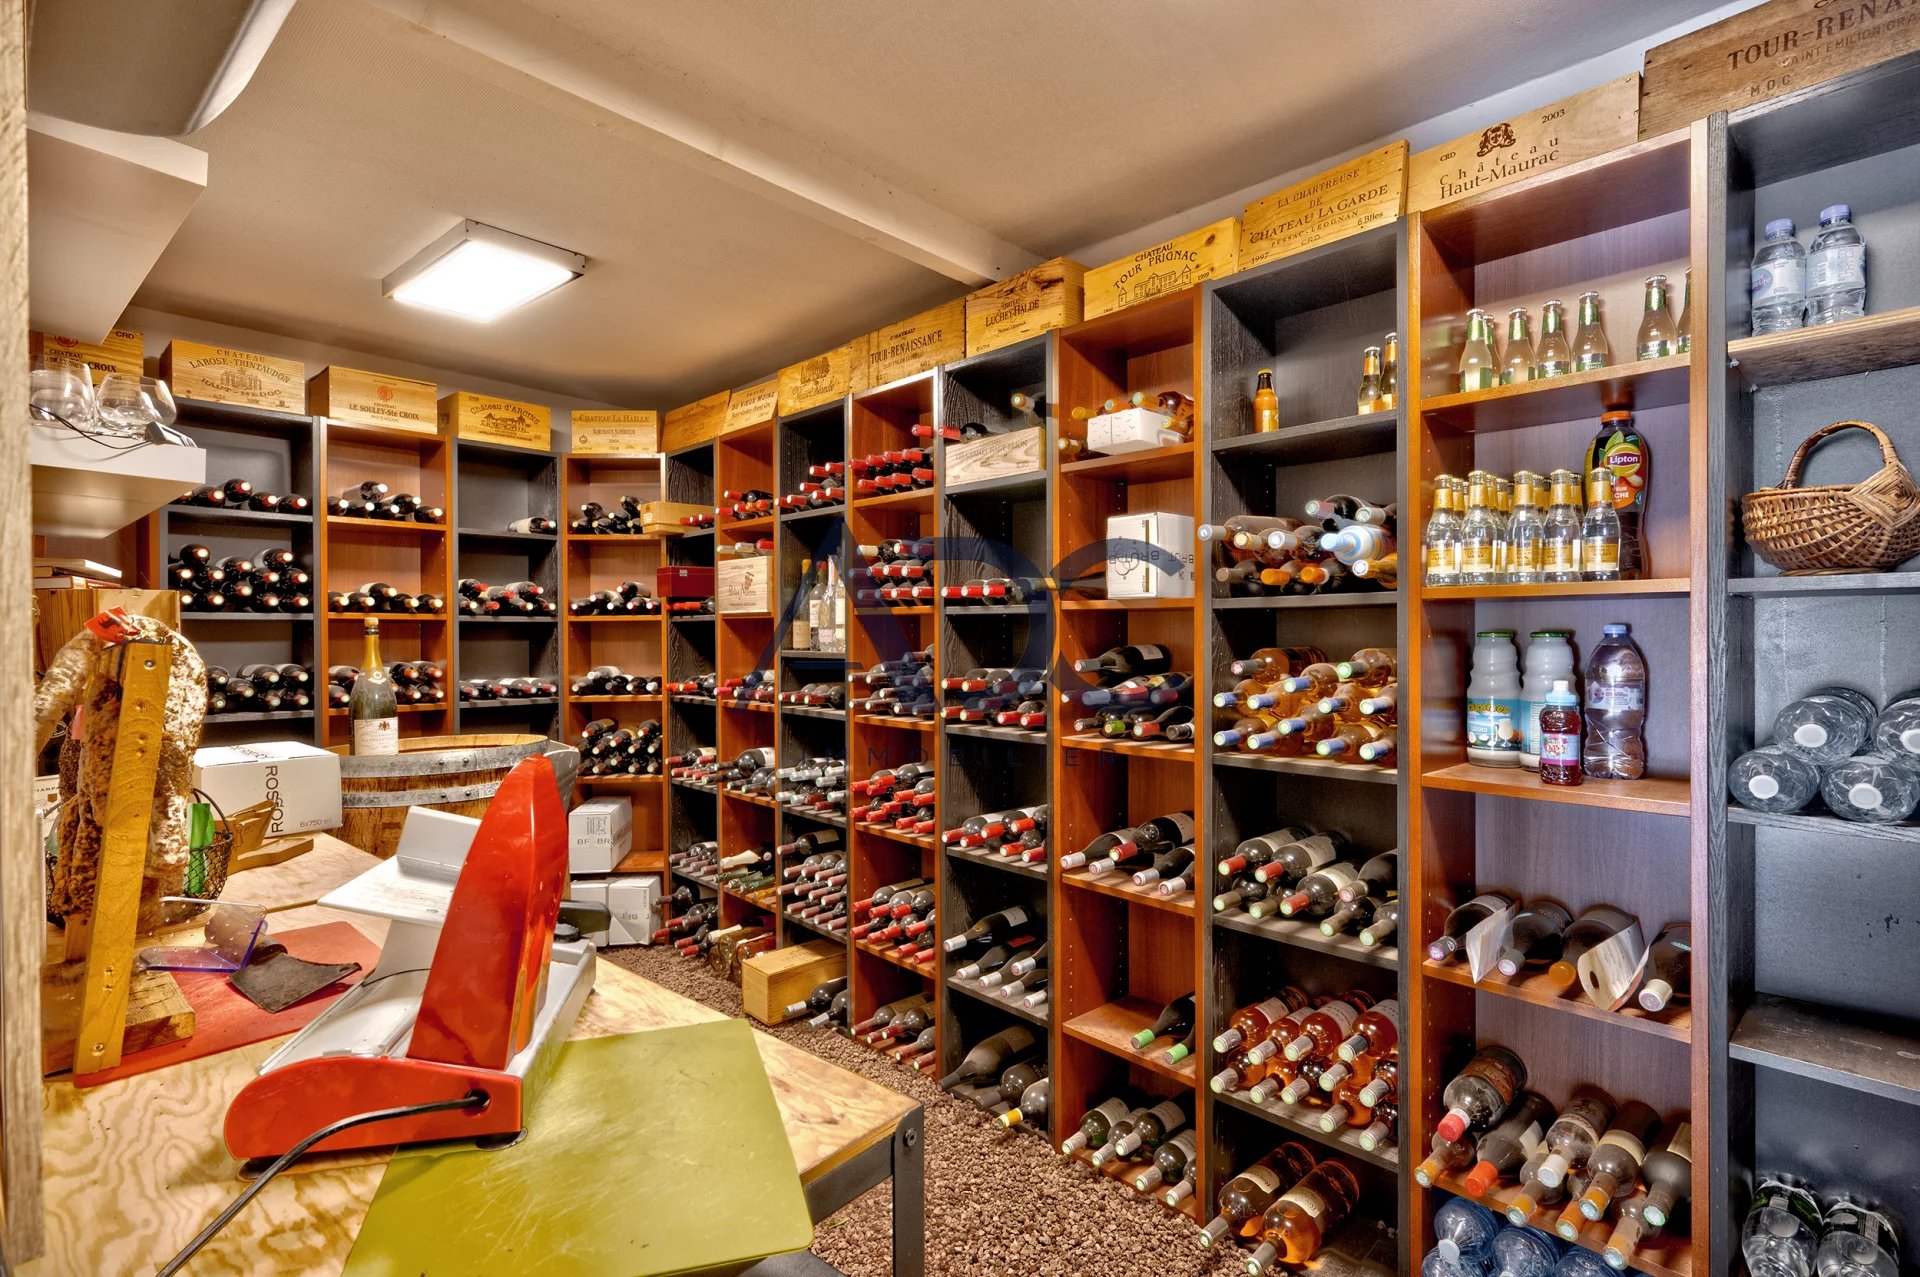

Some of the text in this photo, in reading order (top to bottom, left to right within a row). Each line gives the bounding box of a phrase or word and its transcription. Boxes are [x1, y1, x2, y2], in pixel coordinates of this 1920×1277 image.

[1541, 108, 1566, 124] 2003
[1440, 151, 1457, 162] CRD
[1440, 149, 1560, 200] Haut-Maurac
[1277, 168, 1360, 209] LA CHARTREUSE
[1309, 196, 1323, 209] DE
[1250, 184, 1388, 244] CHATEAU LA GARDE
[1135, 242, 1173, 263] CHATEAU
[1250, 252, 1270, 264] 1997
[1113, 250, 1198, 290] TOUR PRIGNAC
[985, 299, 1040, 328] LUCHEY-HALDE
[49, 349, 83, 359] CHATEAU
[870, 329, 943, 365] TOUR-RENAISSANCE
[216, 349, 265, 362] CHATEAU
[88, 361, 117, 373] CROIX
[349, 403, 359, 411] LE
[359, 405, 398, 417] SOULEY-Ste
[399, 410, 419, 420] CROIX
[1609, 455, 1638, 465] Lipton
[1613, 491, 1630, 499] CHE
